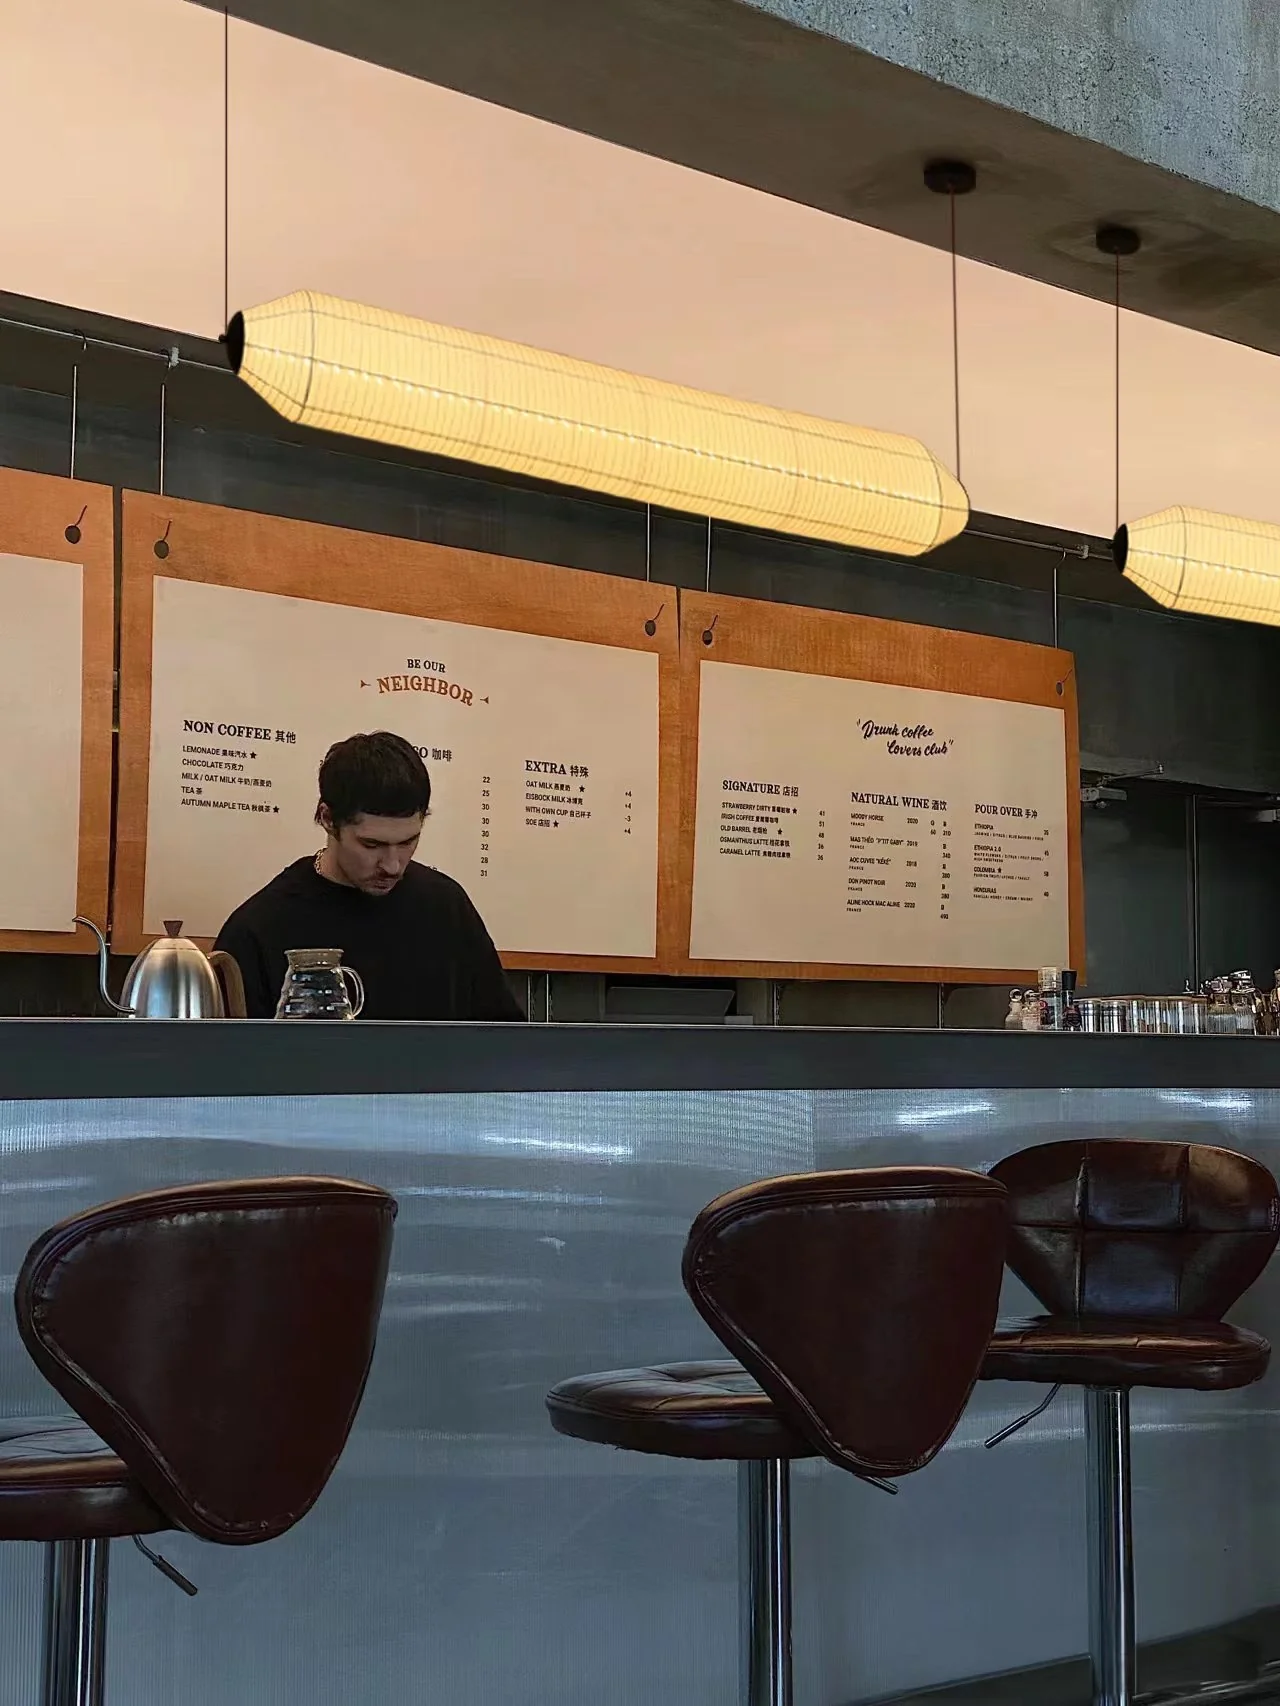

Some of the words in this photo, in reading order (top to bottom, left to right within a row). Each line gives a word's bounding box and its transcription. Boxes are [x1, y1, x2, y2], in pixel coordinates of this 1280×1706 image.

[407, 659, 421, 669] BE
[424, 660, 446, 673] OUR
[377, 675, 473, 706] NEIGHBOR
[183, 720, 214, 734] NON
[218, 724, 271, 740] COFFEE
[275, 730, 296, 744] 其他
[183, 746, 220, 755] LEMONADE
[432, 748, 452, 762] 咖啡
[182, 758, 223, 769] CHOCOLATE
[224, 762, 244, 771] 巧克力
[525, 760, 567, 775] EXTRA
[570, 765, 589, 778] 特殊
[220, 776, 236, 784] MILK
[526, 780, 537, 788] OAT
[181, 786, 194, 794] TEA
[722, 780, 780, 794] SIGNATURE
[783, 786, 798, 797] 店招
[526, 793, 550, 801] EISBOCK
[851, 792, 898, 806] NATURAL
[901, 797, 929, 809] WINE
[181, 798, 211, 807] AUTUMN
[213, 801, 236, 809] MAPLE
[237, 803, 250, 811] TEA
[722, 802, 755, 810] STRAWBERRY
[975, 804, 998, 815] POUR
[1000, 806, 1023, 817] OVER
[720, 836, 752, 844] OSMANTHUS
